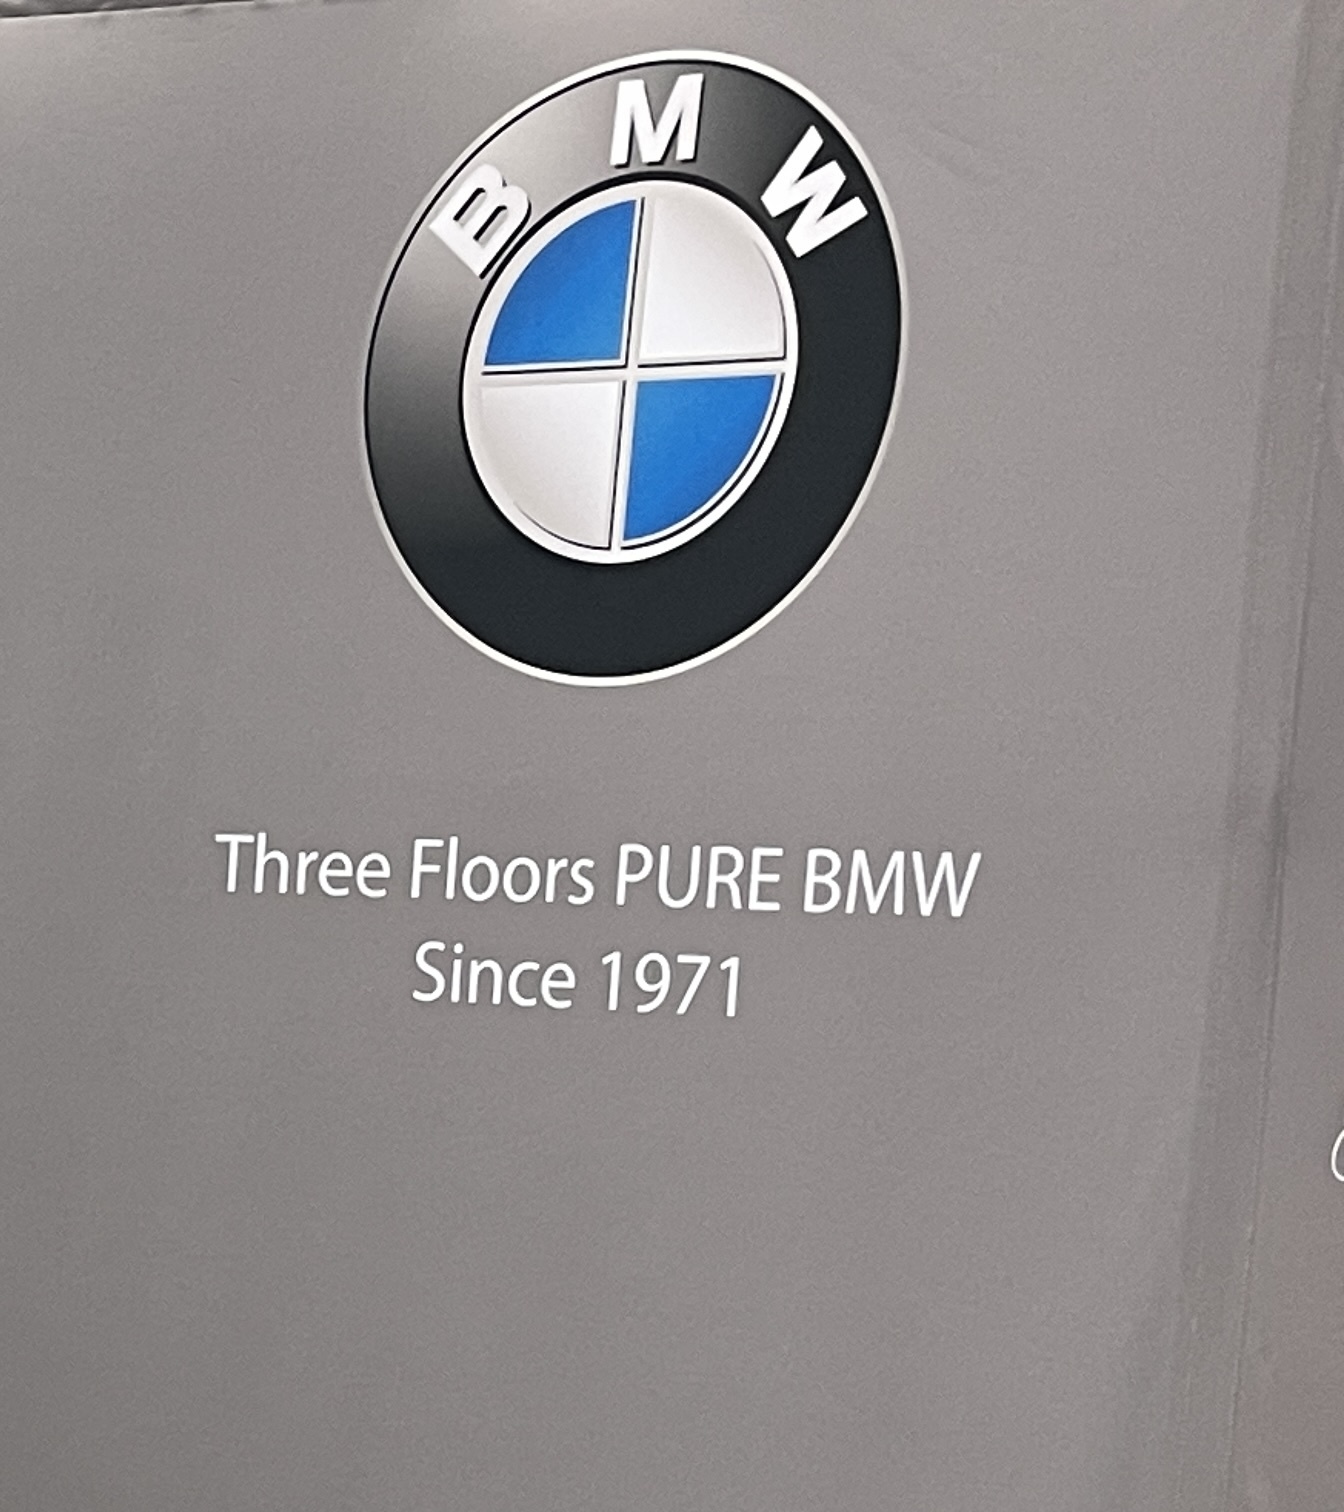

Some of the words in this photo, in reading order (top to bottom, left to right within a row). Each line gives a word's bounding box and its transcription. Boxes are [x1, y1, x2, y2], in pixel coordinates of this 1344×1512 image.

[429, 72, 868, 277] BMW
[214, 832, 392, 899] Three
[409, 836, 596, 905] Floors
[615, 842, 785, 912] PURE
[802, 847, 983, 918] BMW
[411, 940, 577, 1010] Since
[600, 950, 742, 1018] 1971
